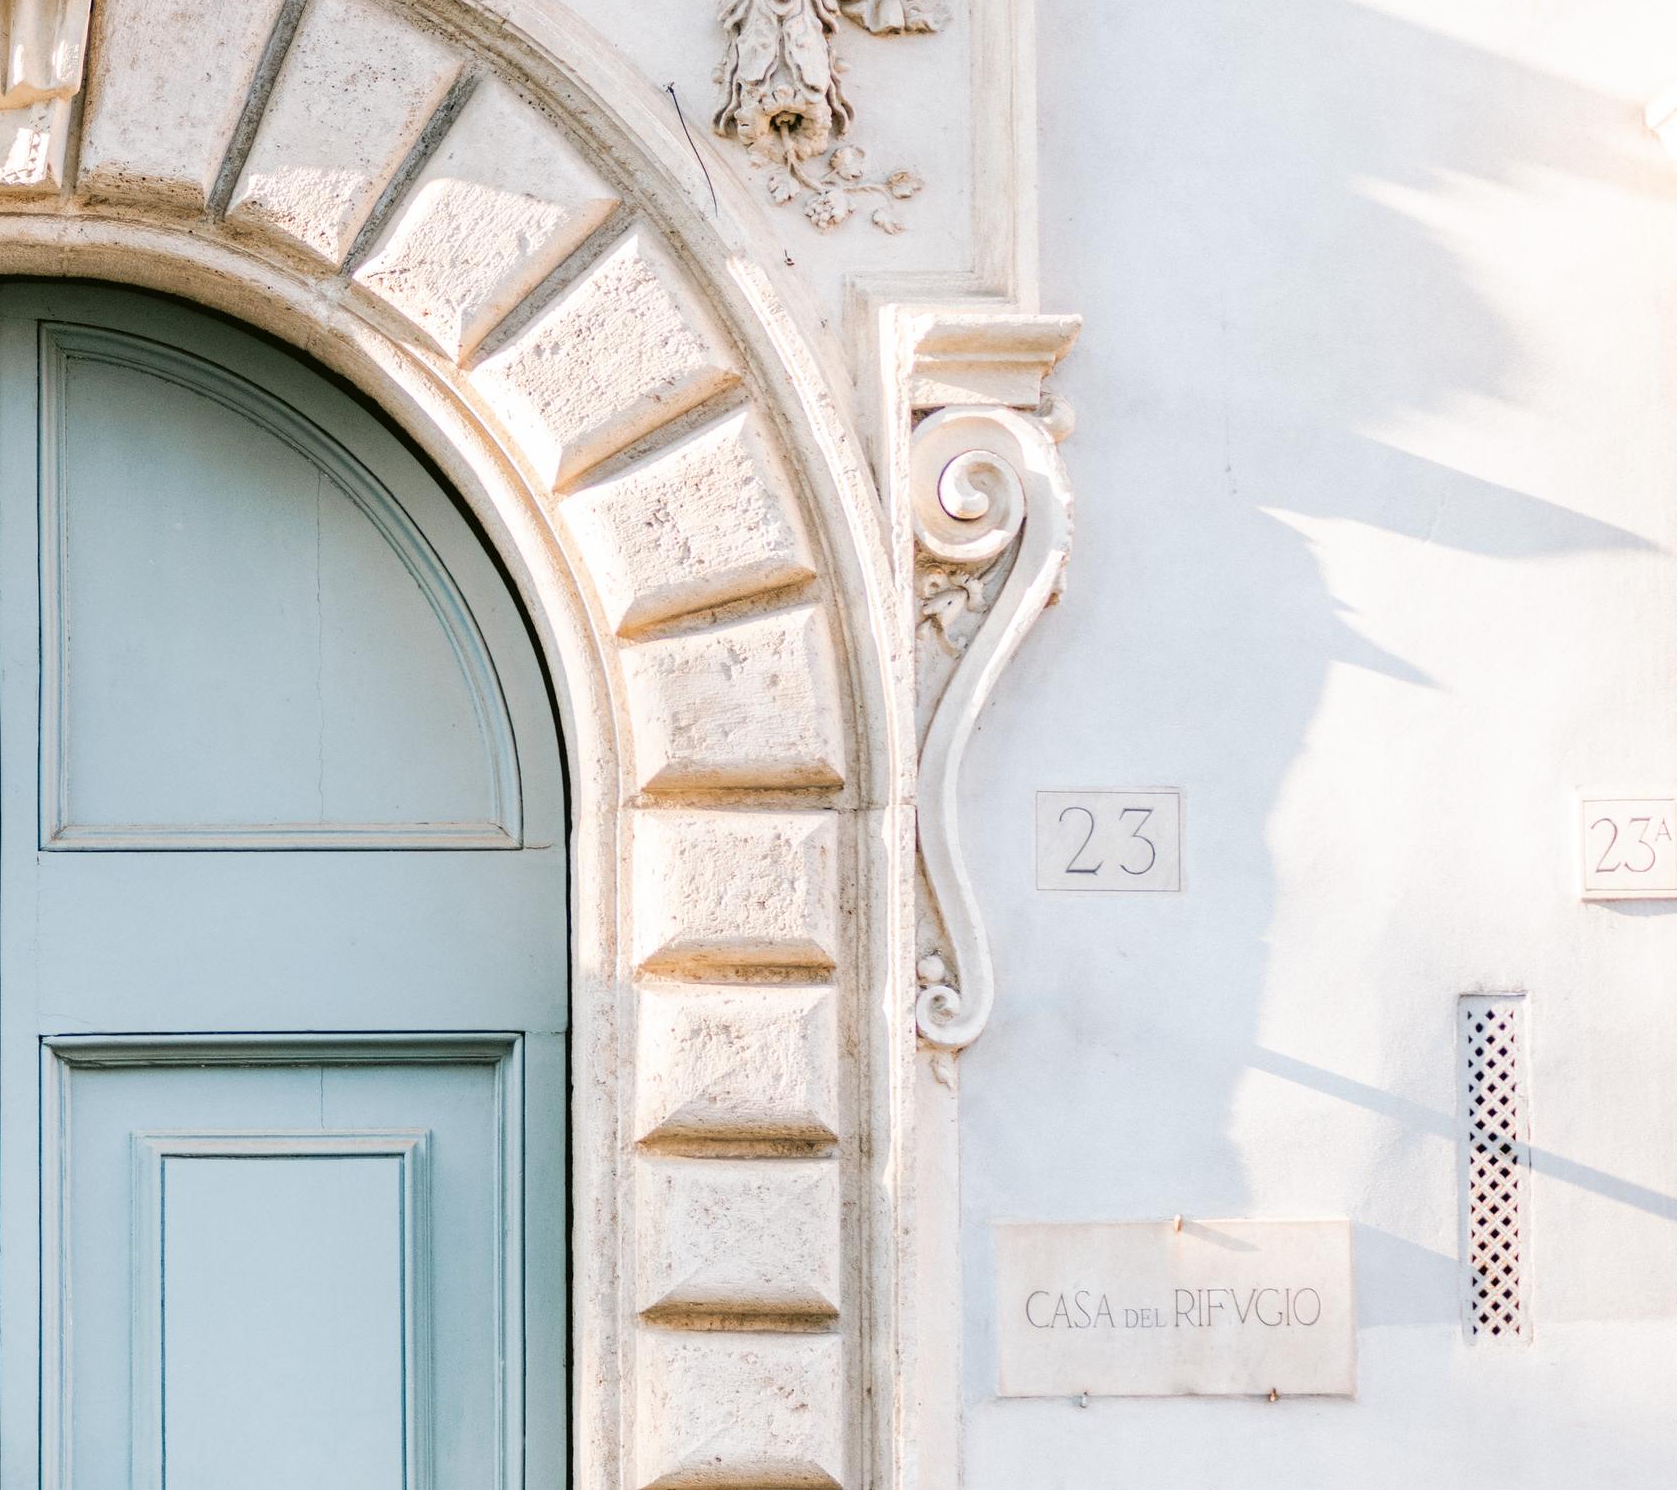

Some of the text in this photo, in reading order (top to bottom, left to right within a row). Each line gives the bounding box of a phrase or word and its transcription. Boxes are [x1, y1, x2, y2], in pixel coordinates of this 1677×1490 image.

[1058, 806, 1157, 876] 23
[1589, 816, 1673, 874] 23A
[1025, 1286, 1322, 1329] CASA DEL RIFVGIO
